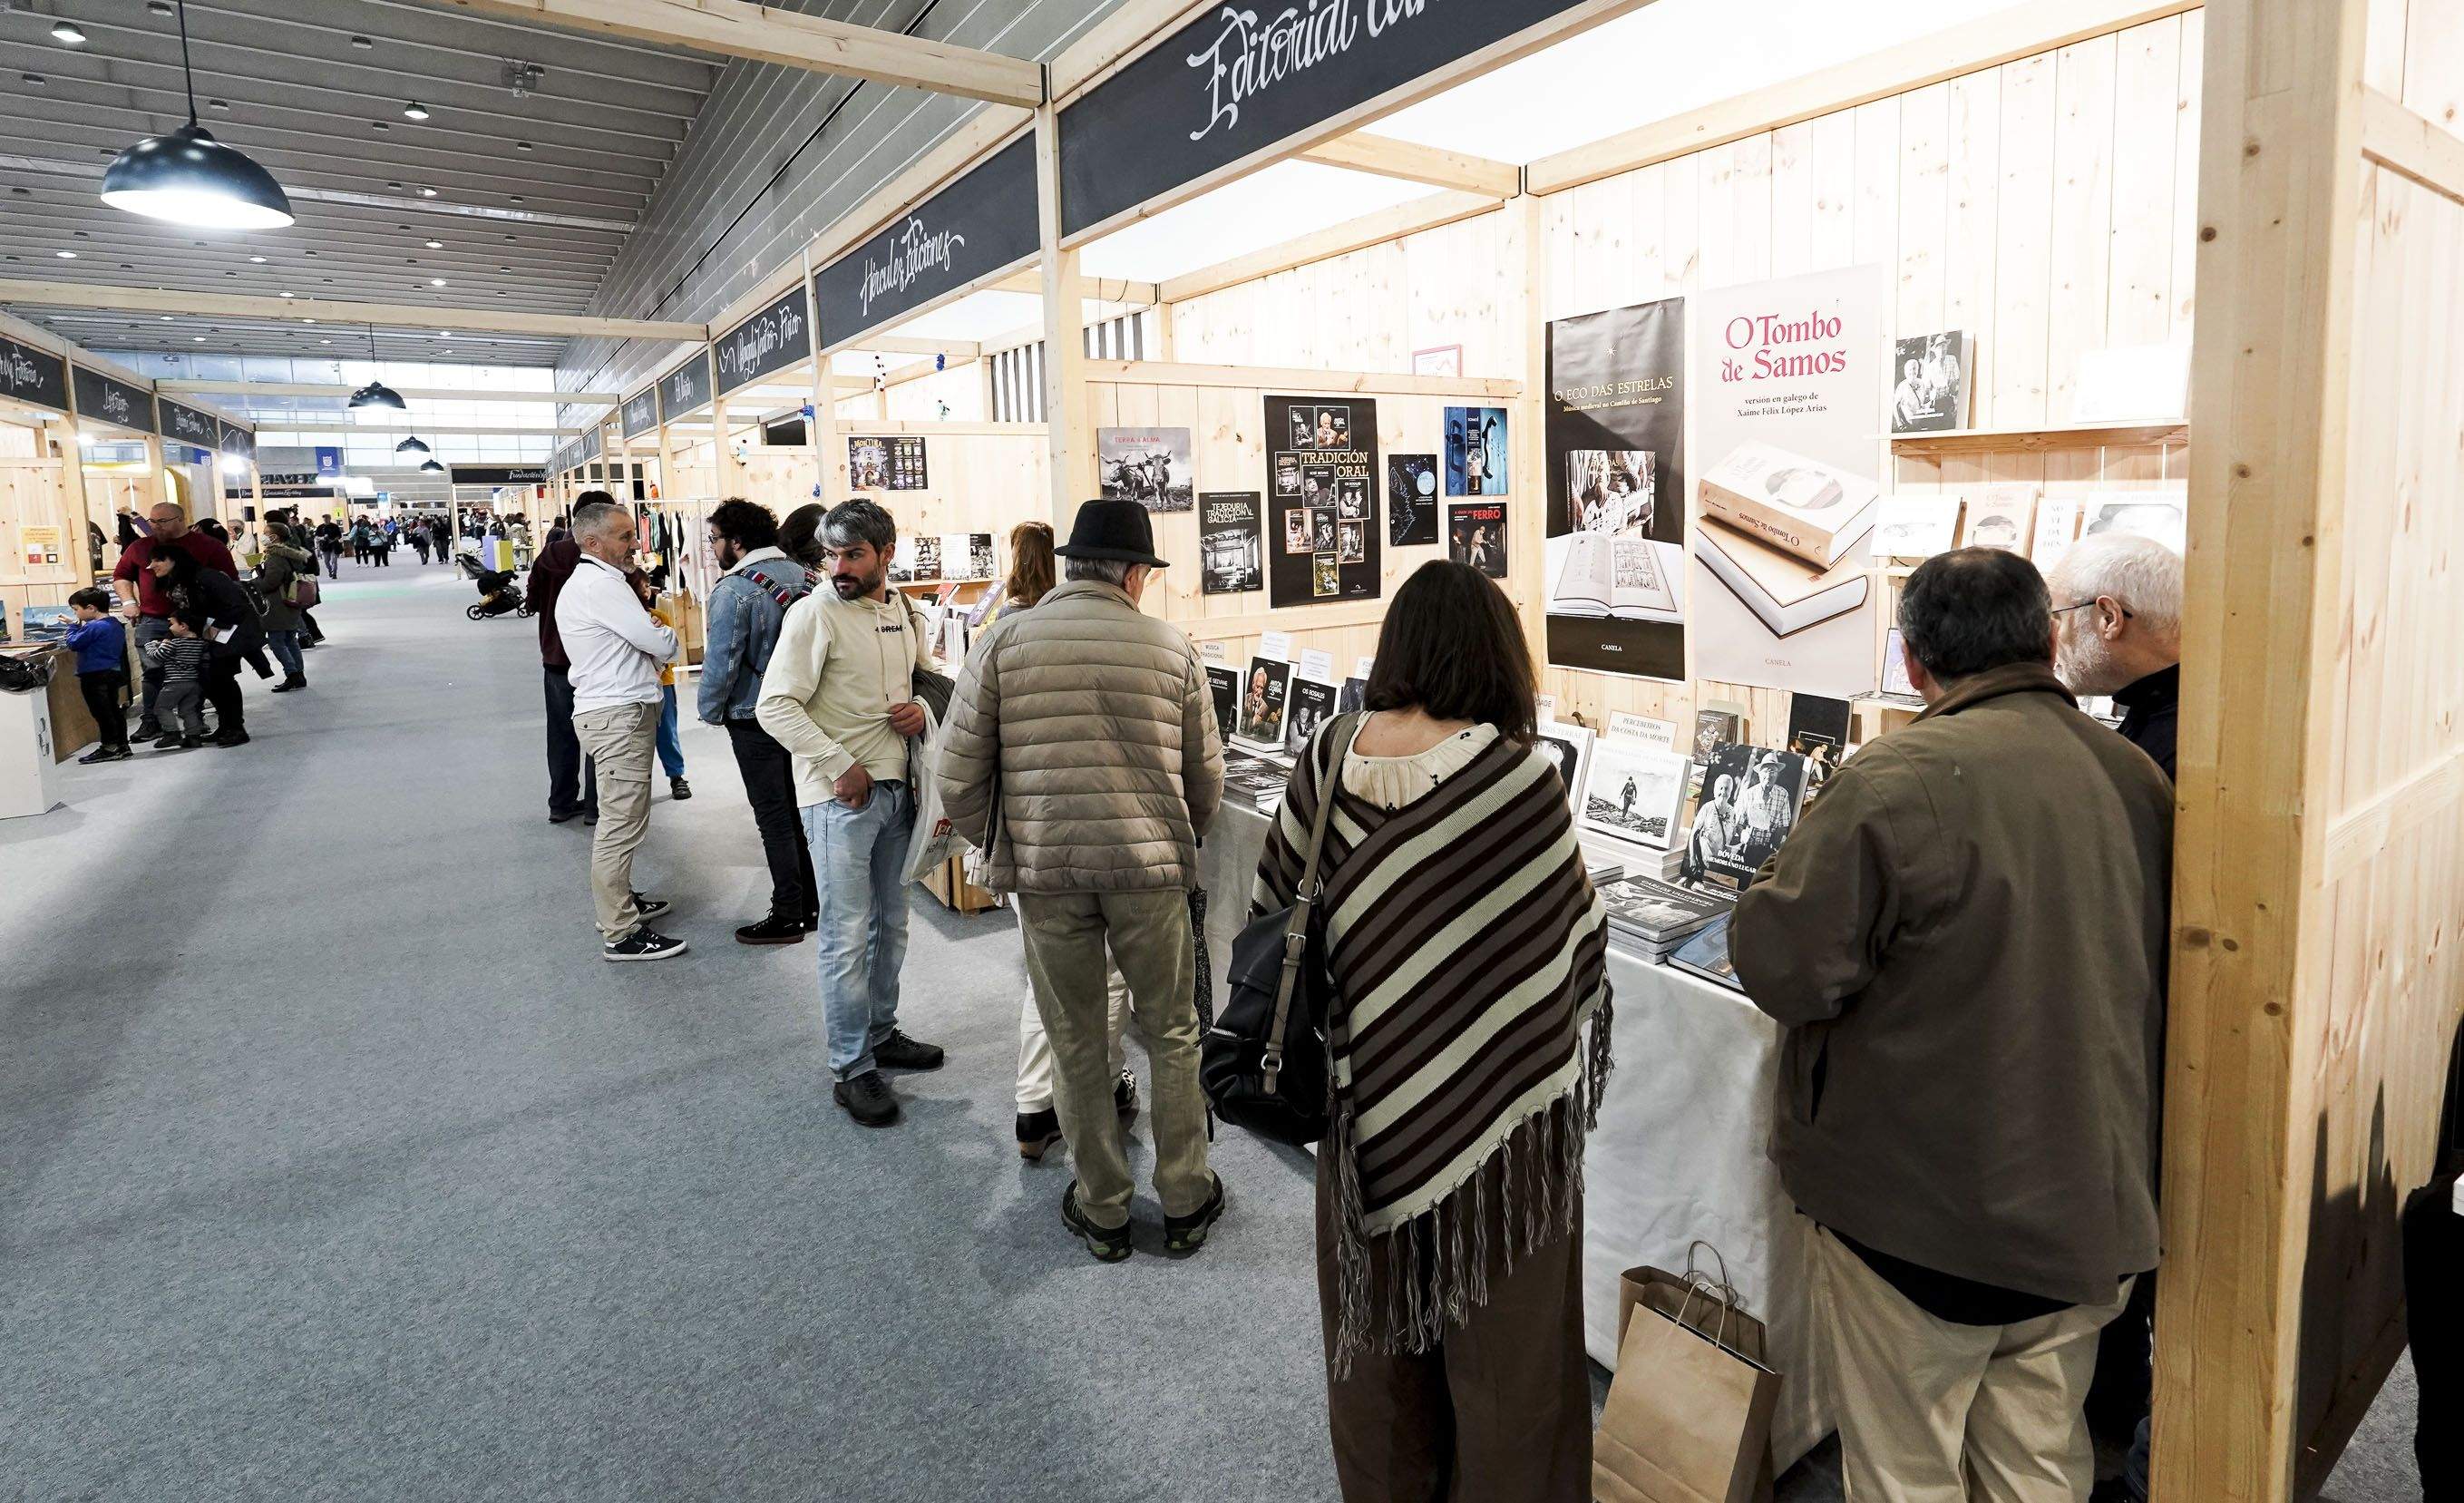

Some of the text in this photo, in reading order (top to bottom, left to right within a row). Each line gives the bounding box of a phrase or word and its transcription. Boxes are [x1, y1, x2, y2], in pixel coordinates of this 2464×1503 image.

[1186, 0, 1359, 142] Editorial
[900, 216, 966, 287] Ediciones
[1725, 310, 1842, 349] O Tombo
[1721, 348, 1847, 383] de Samos
[1554, 376, 1673, 402] O ECO DAS ESTRELAS
[1639, 396, 1662, 405] Santiago
[1783, 393, 1807, 405] galego
[1808, 392, 1818, 401] de
[1806, 405, 1827, 413] Arias
[1301, 449, 1368, 464] TRADICIÓN
[1336, 465, 1368, 477] ORAL
[1473, 509, 1501, 520] FERRO
[1790, 536, 1799, 547] O
[1601, 643, 1622, 652] CANELA
[1765, 658, 1792, 667] CANELA
[1622, 717, 1661, 730] PERCEBEIROS
[1621, 727, 1639, 737] COSTA
[1640, 730, 1649, 738] DA
[1649, 733, 1670, 743] MORTE
[1717, 849, 1745, 863] BÓVEDA
